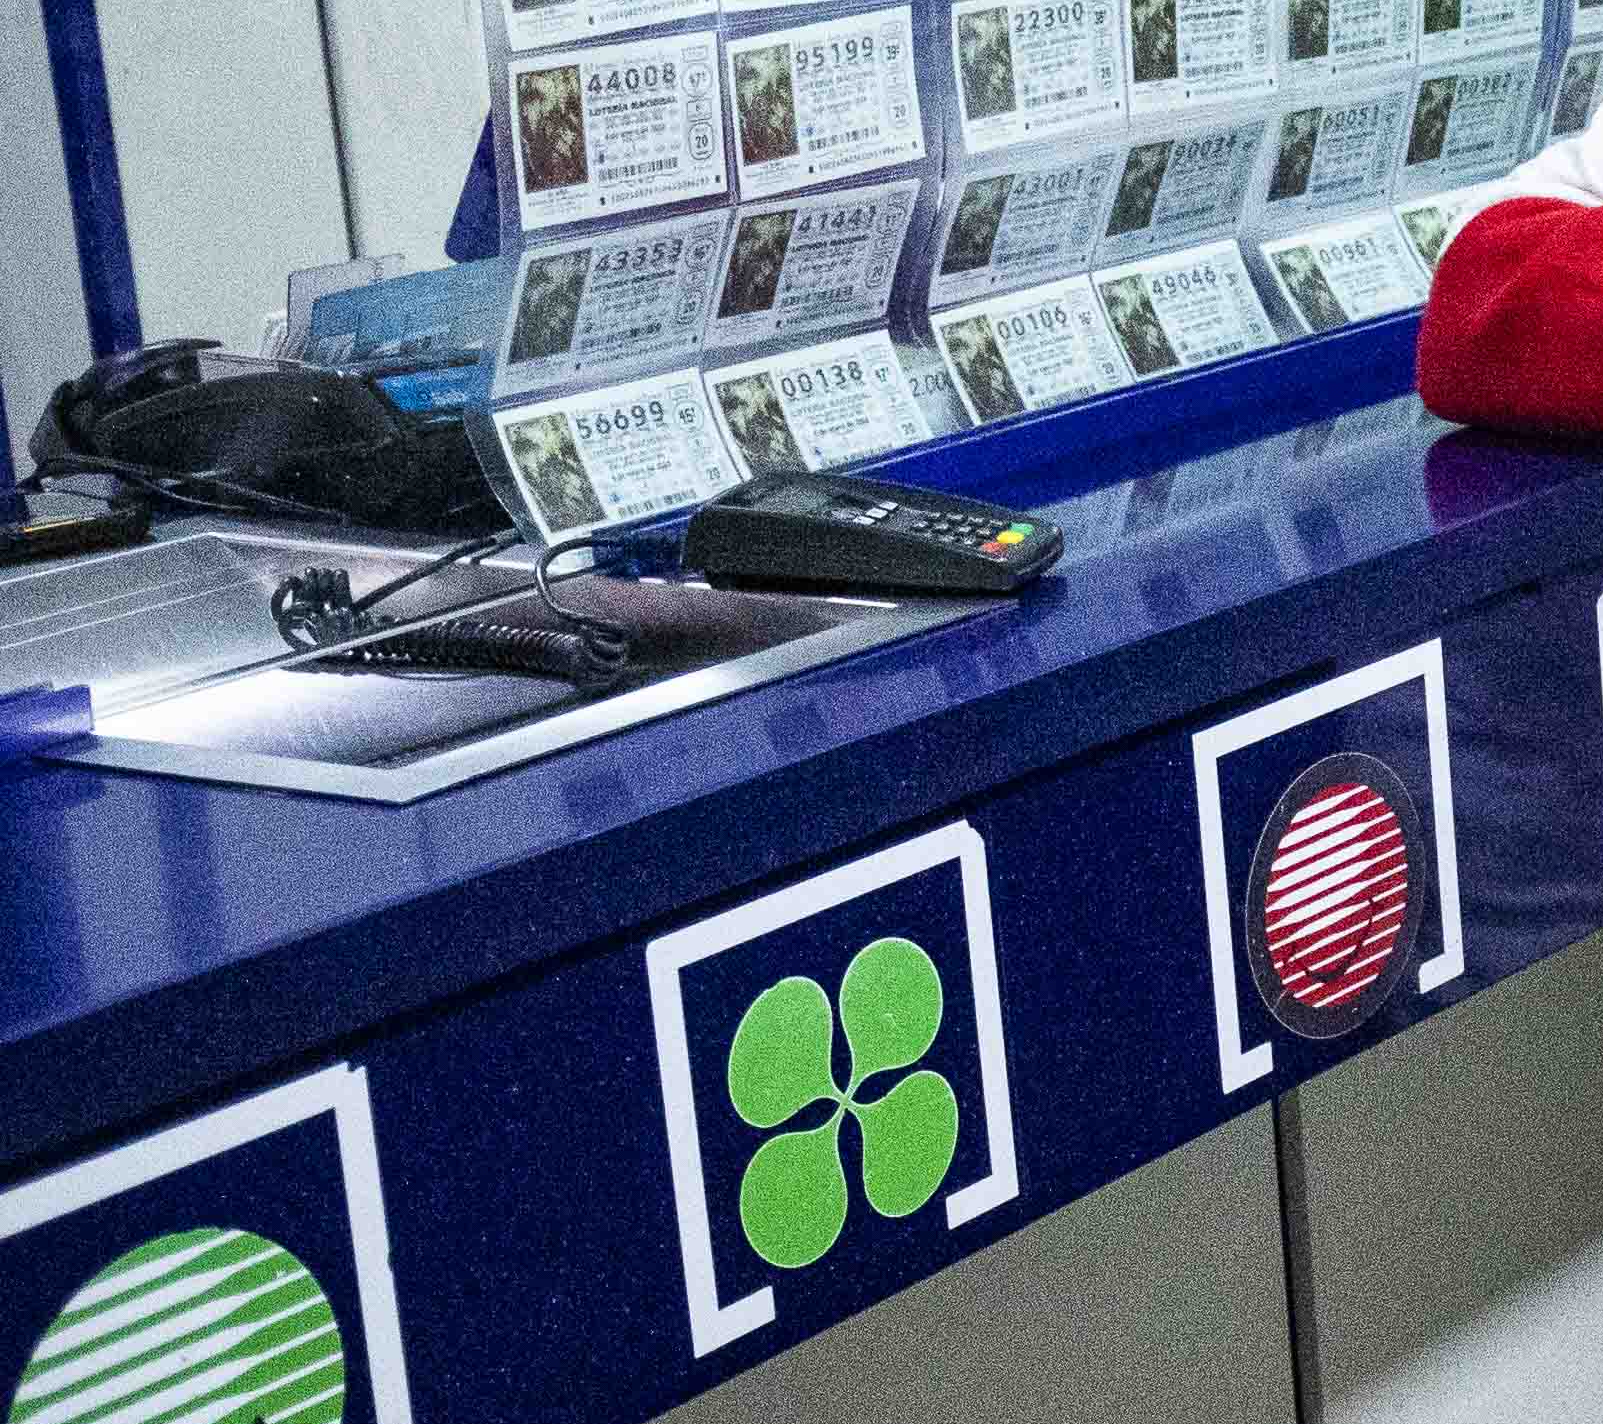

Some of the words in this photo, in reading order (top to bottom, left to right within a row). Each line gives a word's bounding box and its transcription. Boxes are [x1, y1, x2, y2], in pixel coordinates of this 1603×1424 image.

[1015, 3, 1084, 33] 22300
[797, 38, 875, 68] 95199
[587, 64, 677, 94] 44008
[996, 305, 1067, 341] 00106
[781, 360, 864, 398] 00138
[576, 400, 665, 440] 56699
